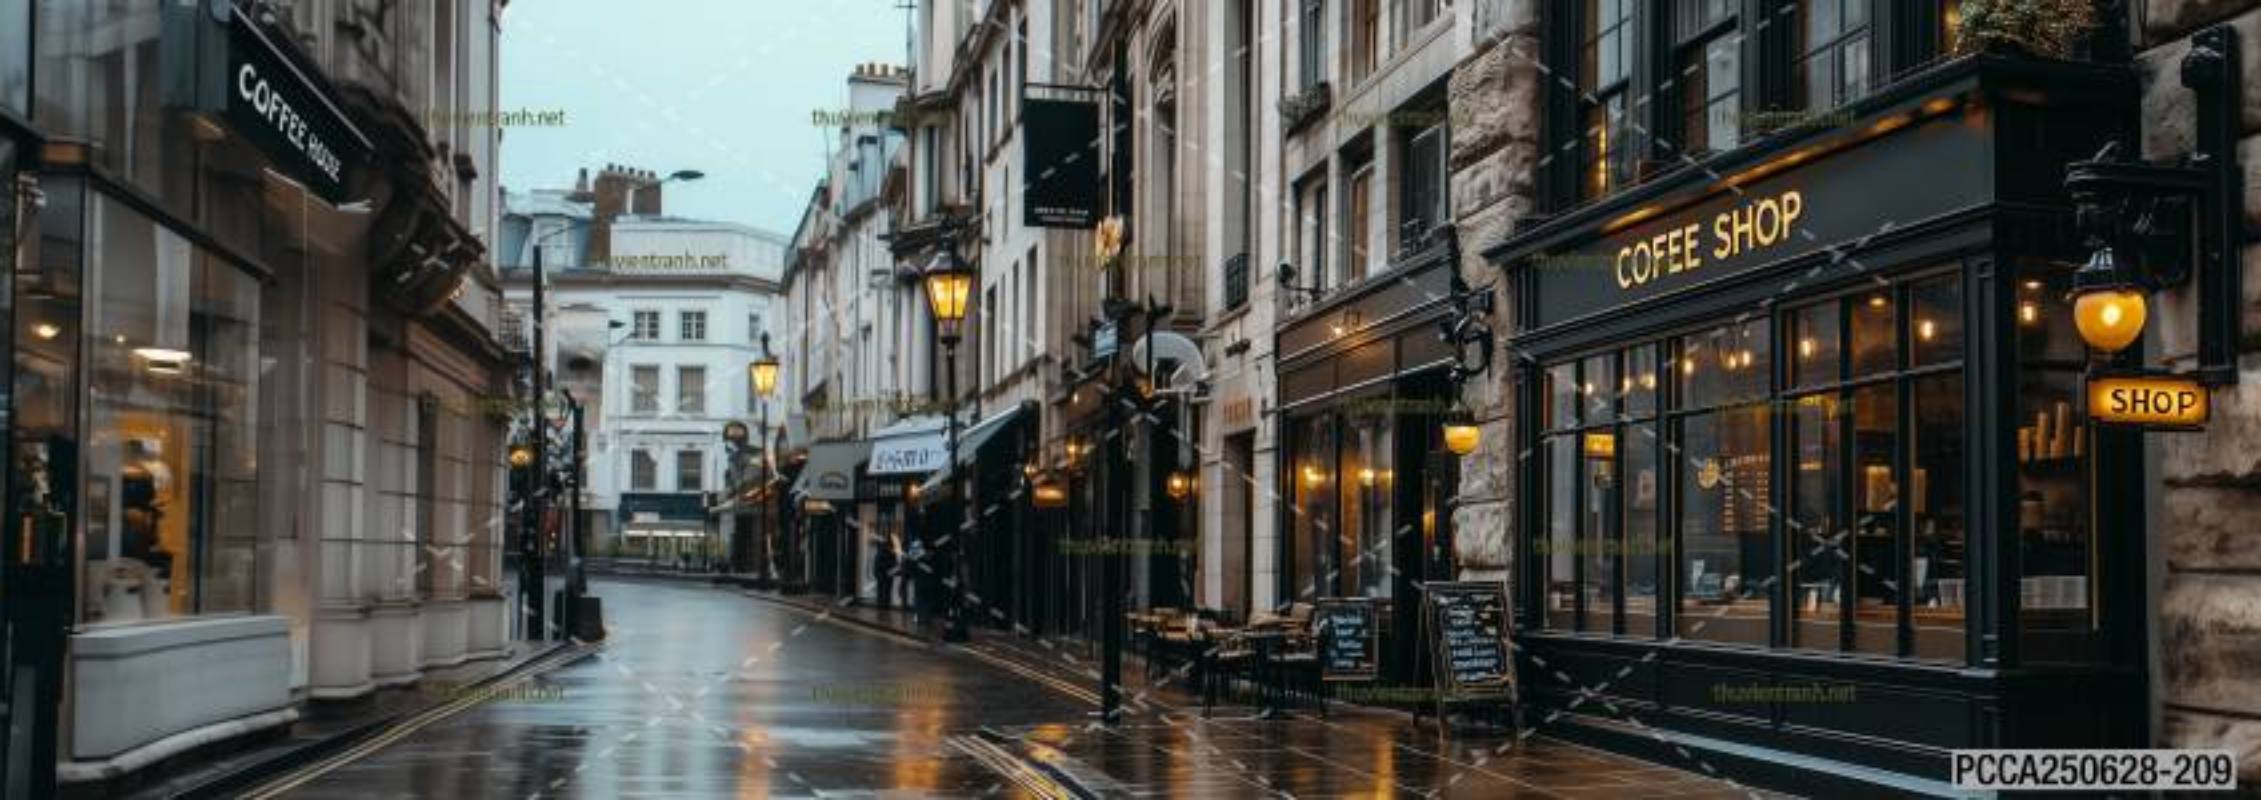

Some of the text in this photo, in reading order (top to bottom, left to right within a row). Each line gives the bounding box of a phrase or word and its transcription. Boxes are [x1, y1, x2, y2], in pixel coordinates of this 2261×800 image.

[239, 63, 307, 150] COFFEE
[1616, 190, 1801, 289] COFEE SHOP
[2111, 388, 2197, 415] SHOP
